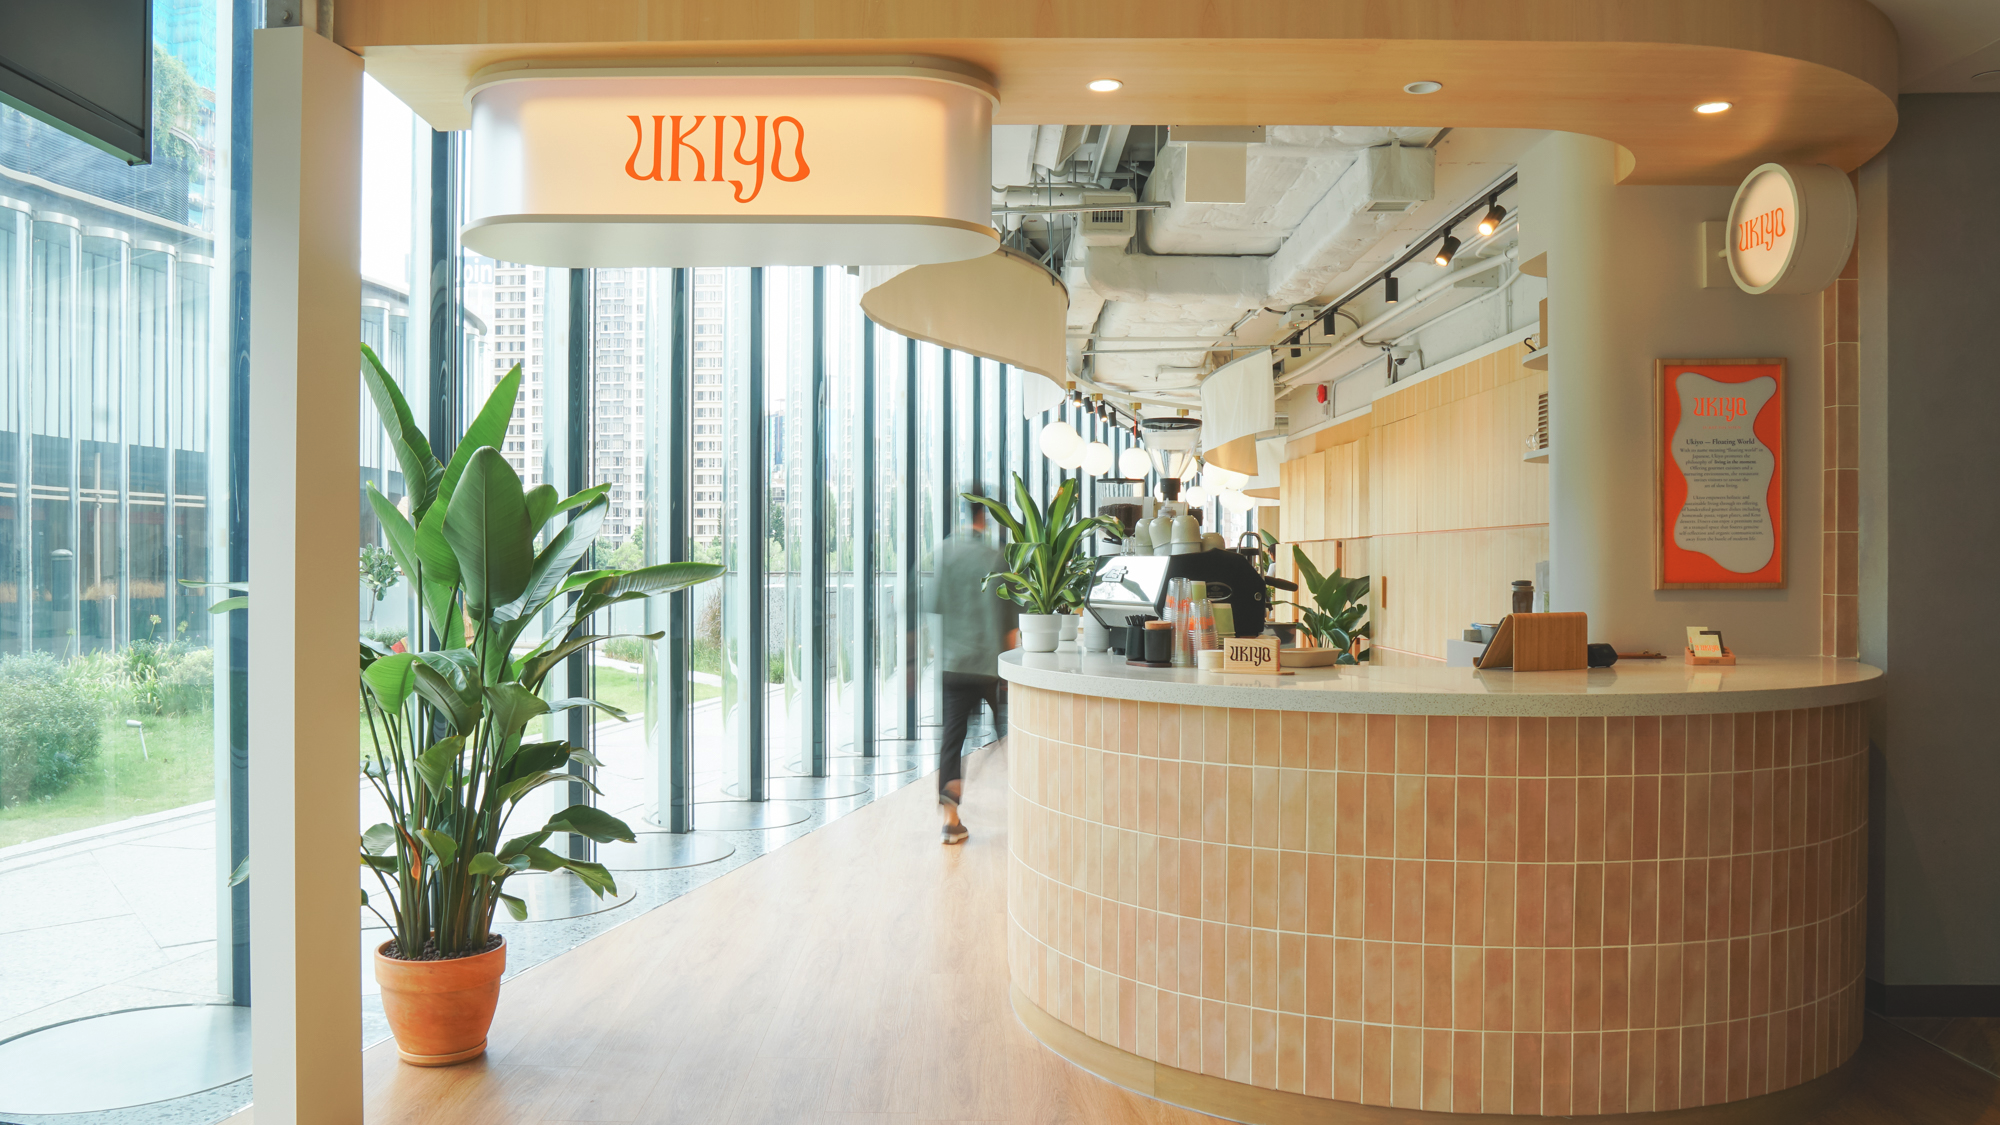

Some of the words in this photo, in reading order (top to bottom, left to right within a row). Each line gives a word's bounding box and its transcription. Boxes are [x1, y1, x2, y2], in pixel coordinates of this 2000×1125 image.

[625, 115, 810, 203] UKIYO
[1739, 207, 1786, 251] UKIYO
[1693, 397, 1748, 422] UKIYO
[1230, 646, 1271, 666] UKIYO
